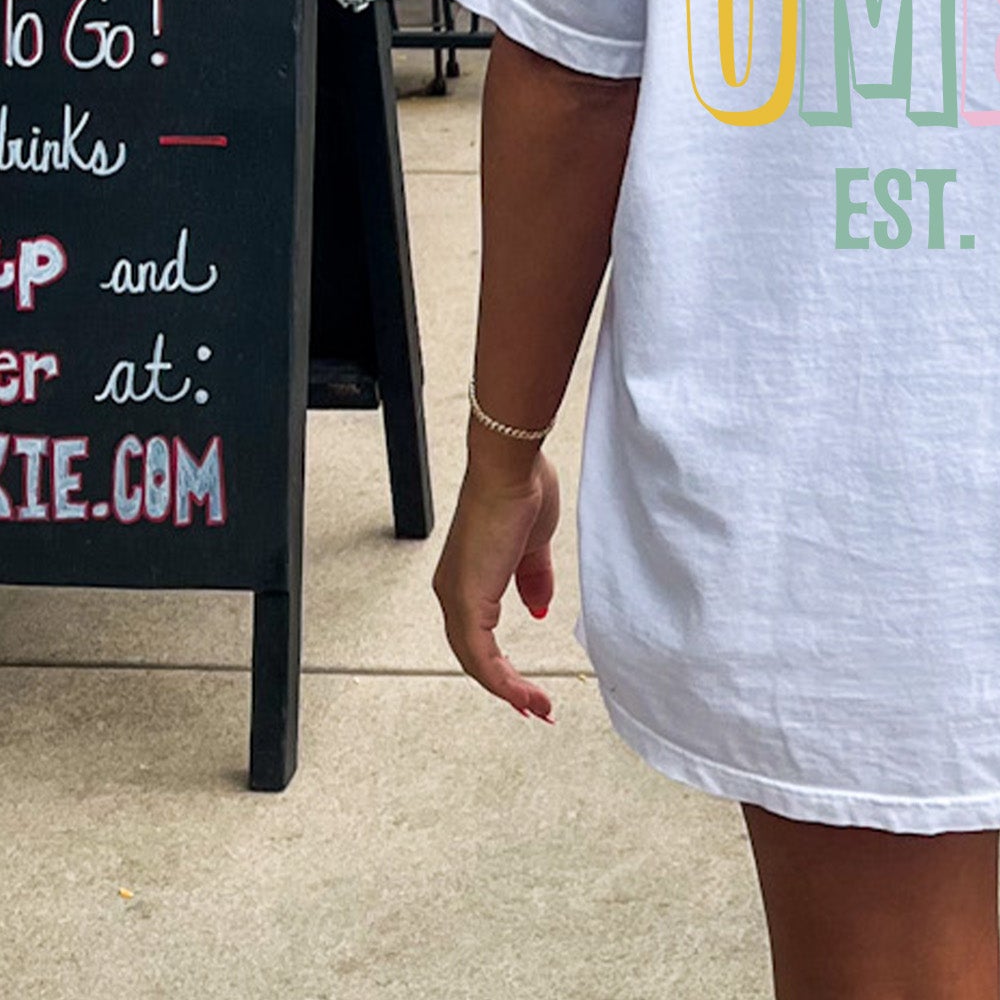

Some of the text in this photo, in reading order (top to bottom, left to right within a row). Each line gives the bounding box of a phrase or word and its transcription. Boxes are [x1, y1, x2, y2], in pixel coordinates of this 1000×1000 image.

[835, 167, 976, 249] EST.
[100, 228, 218, 294] and
[94, 333, 212, 404] at:
